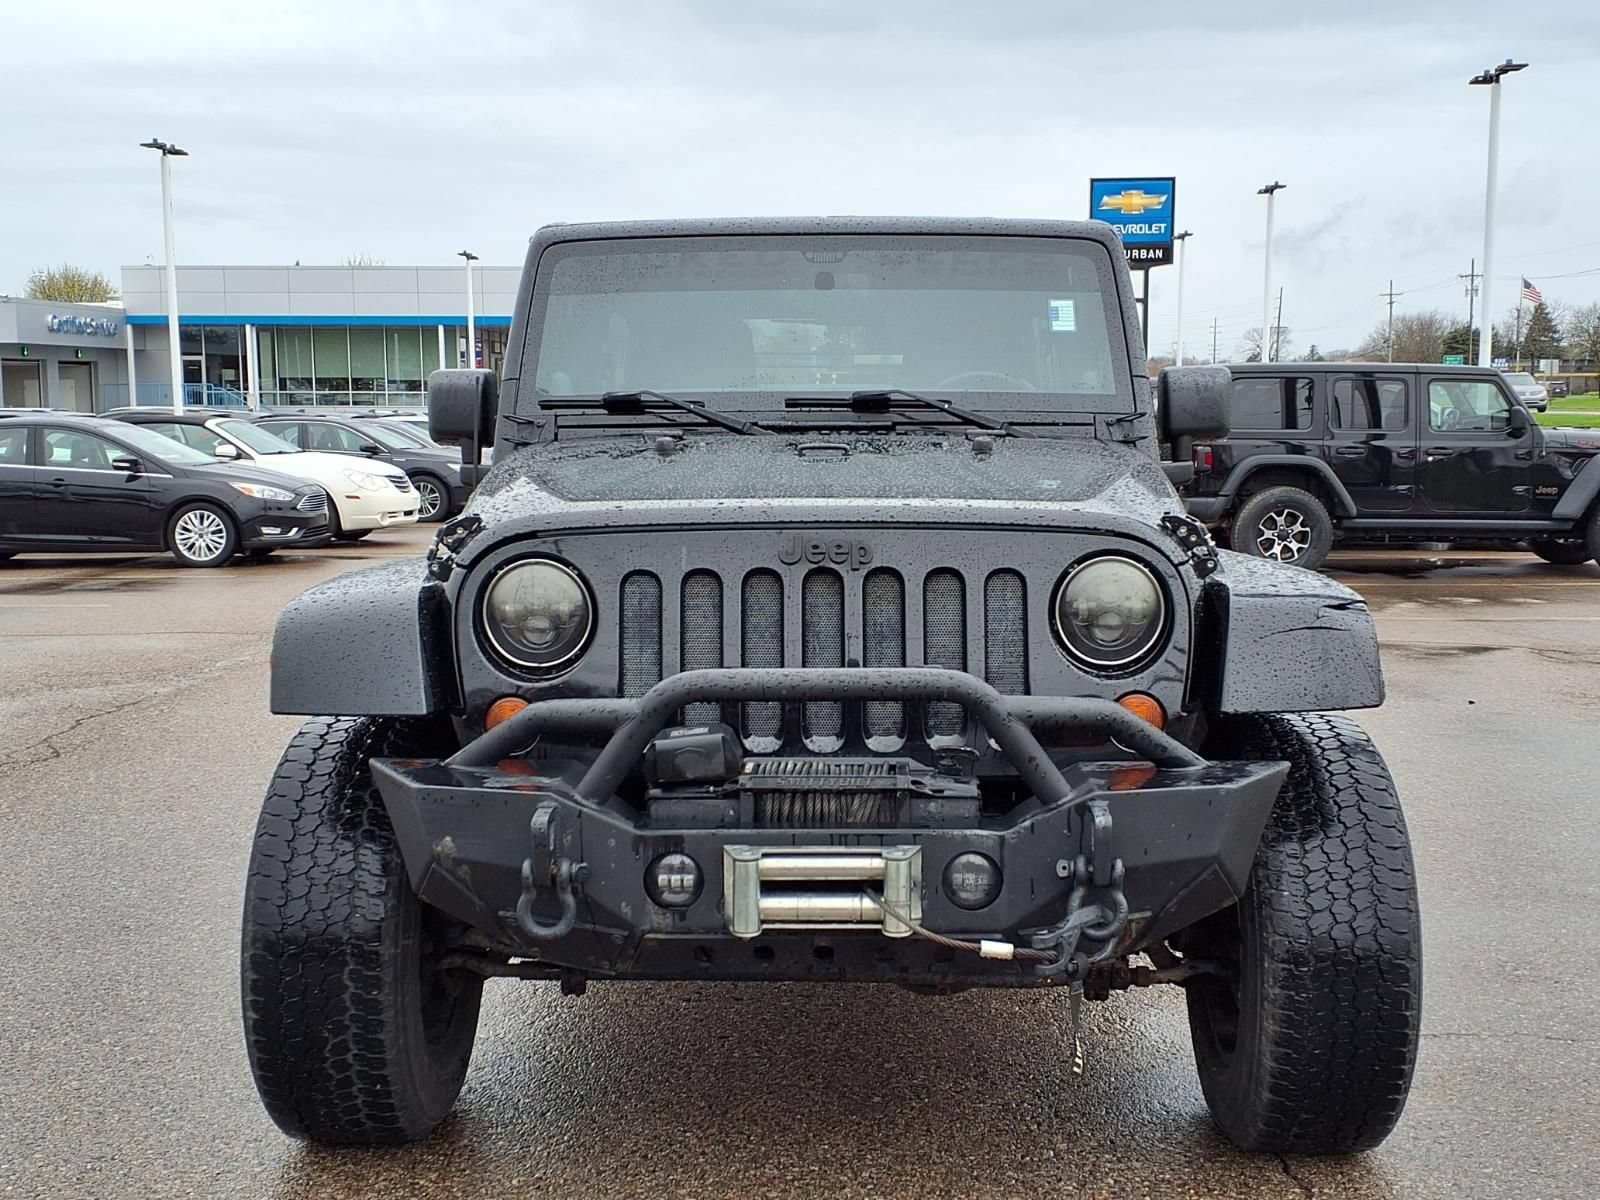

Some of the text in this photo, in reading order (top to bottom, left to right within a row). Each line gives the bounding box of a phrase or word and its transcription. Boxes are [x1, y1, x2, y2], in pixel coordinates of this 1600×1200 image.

[1113, 223, 1167, 234] EVROLET
[1123, 249, 1163, 259] URBAN
[1536, 485, 1559, 495] Jeep
[778, 535, 874, 571] Jeep
